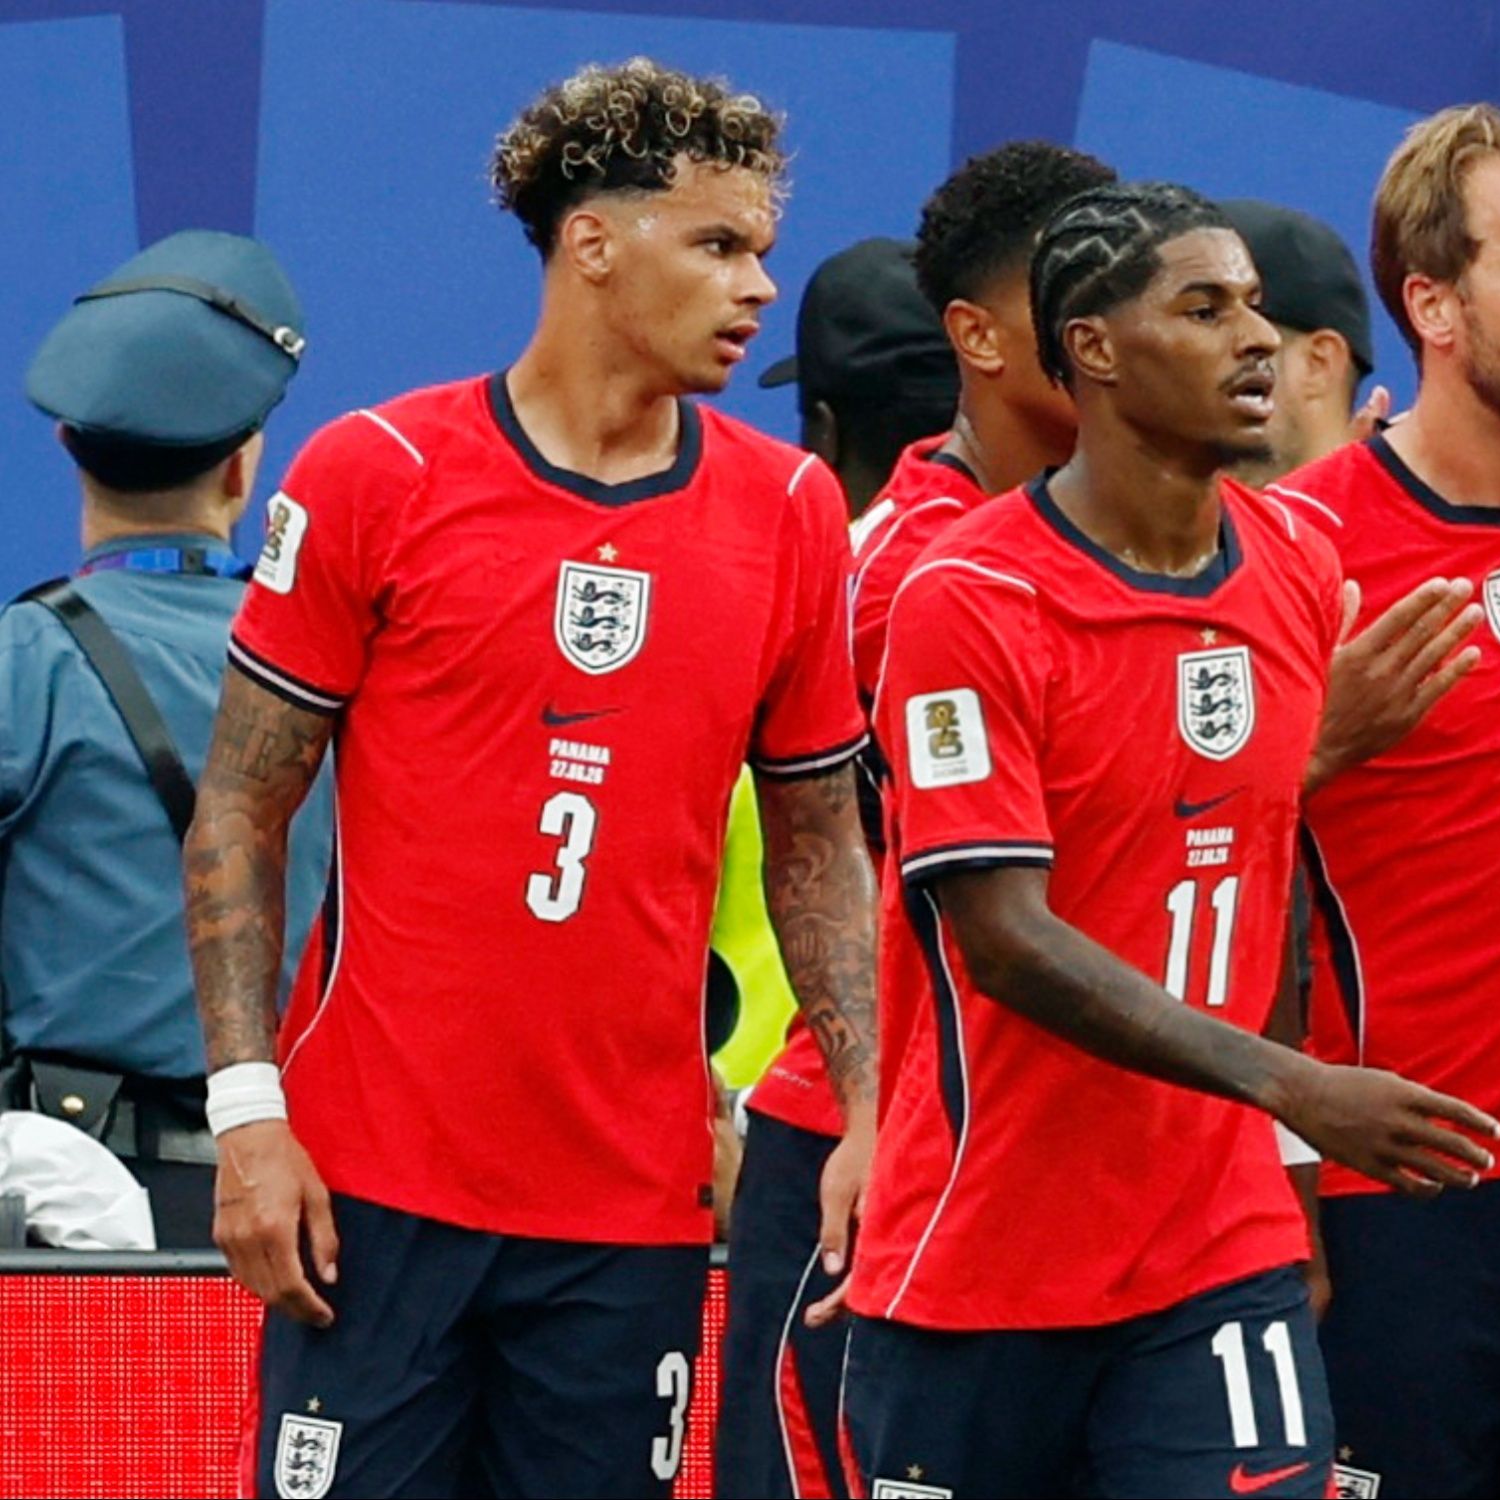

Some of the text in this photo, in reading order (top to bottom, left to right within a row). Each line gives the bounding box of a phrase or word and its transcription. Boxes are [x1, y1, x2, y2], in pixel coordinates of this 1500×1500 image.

[549, 738, 611, 766] PANAMA
[525, 791, 597, 922] 3
[1165, 876, 1239, 1006] 11
[651, 1351, 690, 1480] 3
[1211, 1320, 1307, 1448] 11
